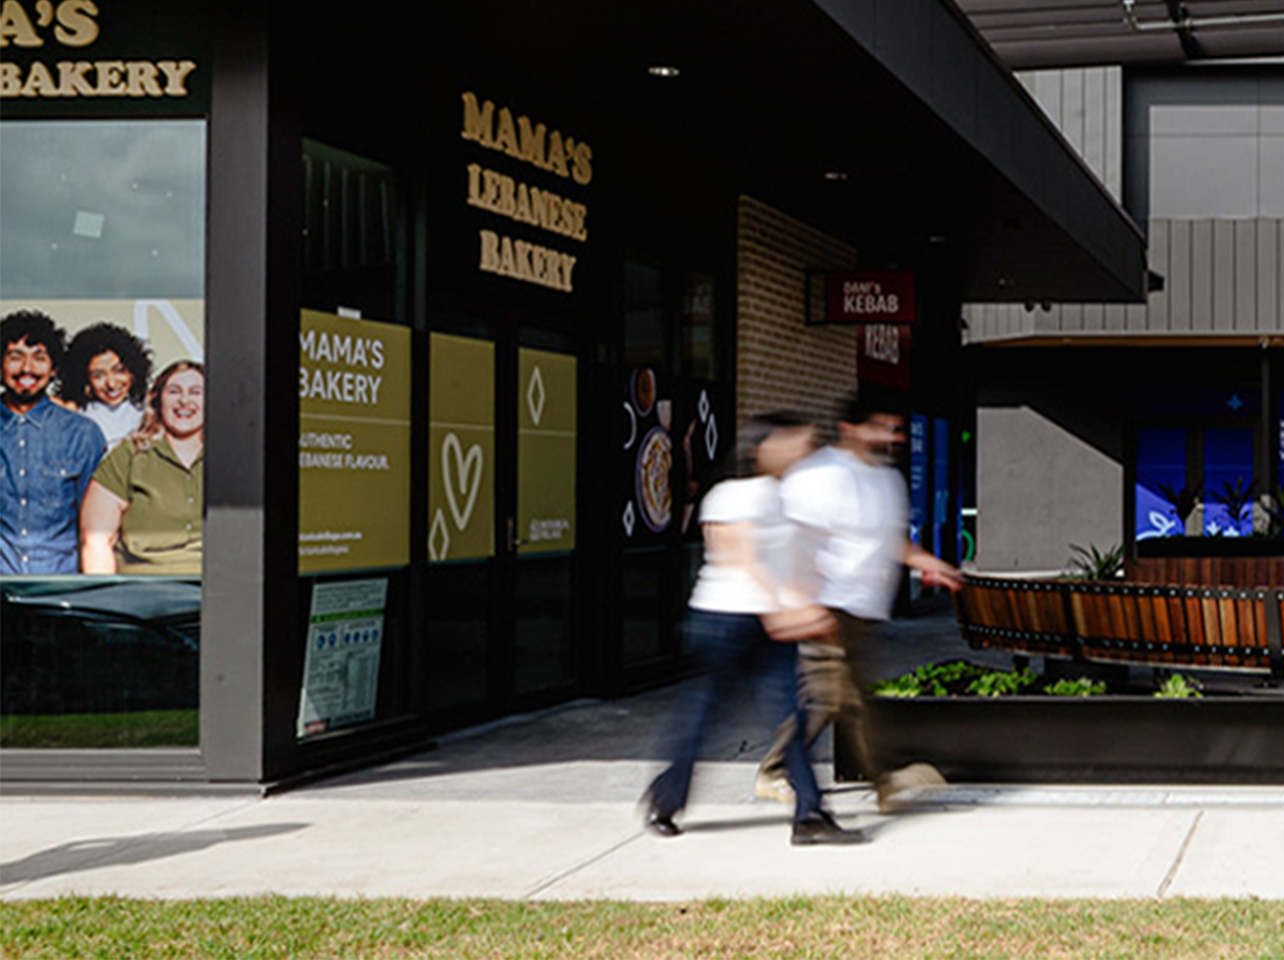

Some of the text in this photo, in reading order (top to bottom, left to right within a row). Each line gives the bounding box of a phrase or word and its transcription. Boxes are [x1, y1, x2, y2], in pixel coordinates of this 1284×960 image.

[0, 60, 197, 98] BAKERY
[461, 90, 593, 186] MAMA'S
[466, 162, 588, 242] LEBANESE
[479, 228, 577, 293] BAKERY
[843, 293, 899, 314] KEBAB
[299, 329, 385, 370] MAMA'S
[299, 367, 382, 404] BAKERY
[299, 432, 353, 450] UTHENTIC
[299, 452, 344, 469] EBANESE
